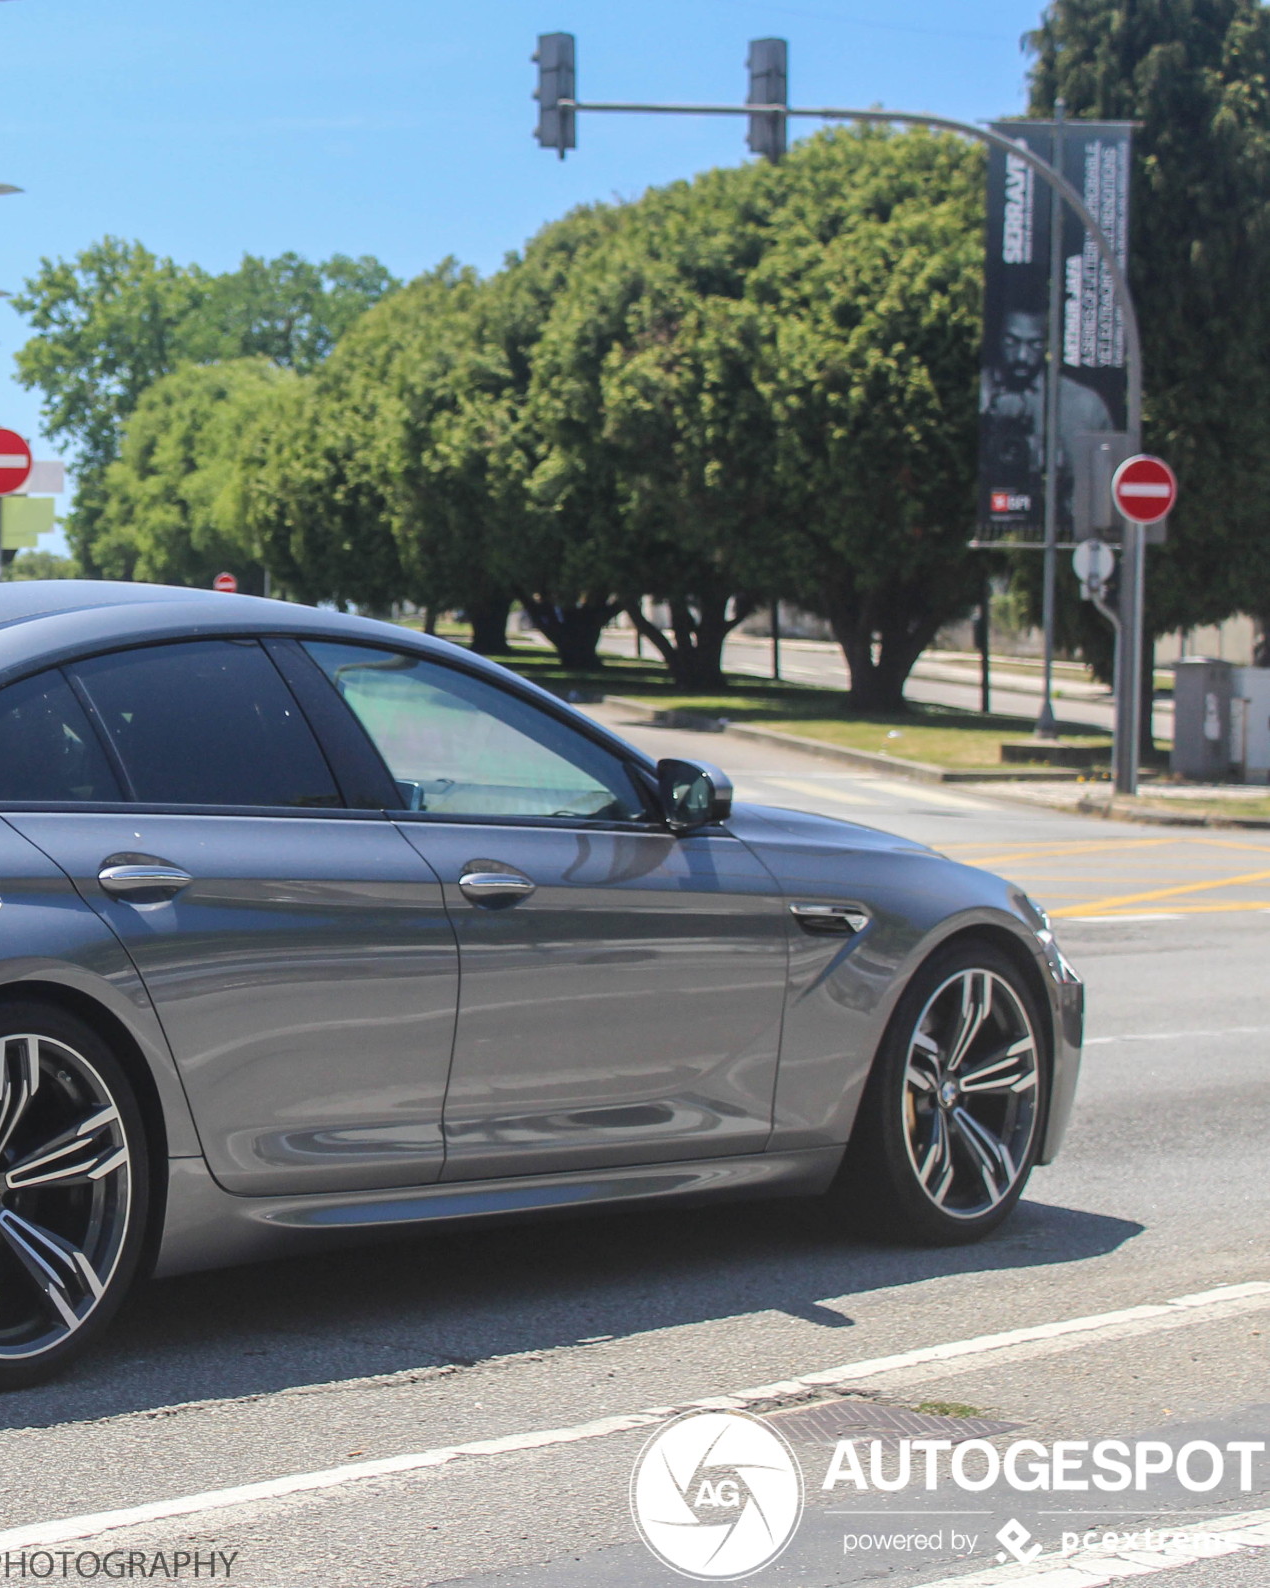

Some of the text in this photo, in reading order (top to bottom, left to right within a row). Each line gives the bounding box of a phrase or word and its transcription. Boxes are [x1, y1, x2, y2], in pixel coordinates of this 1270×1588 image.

[1082, 227, 1099, 288] UTTER
[1063, 254, 1082, 367] ARTHUR JAFA
